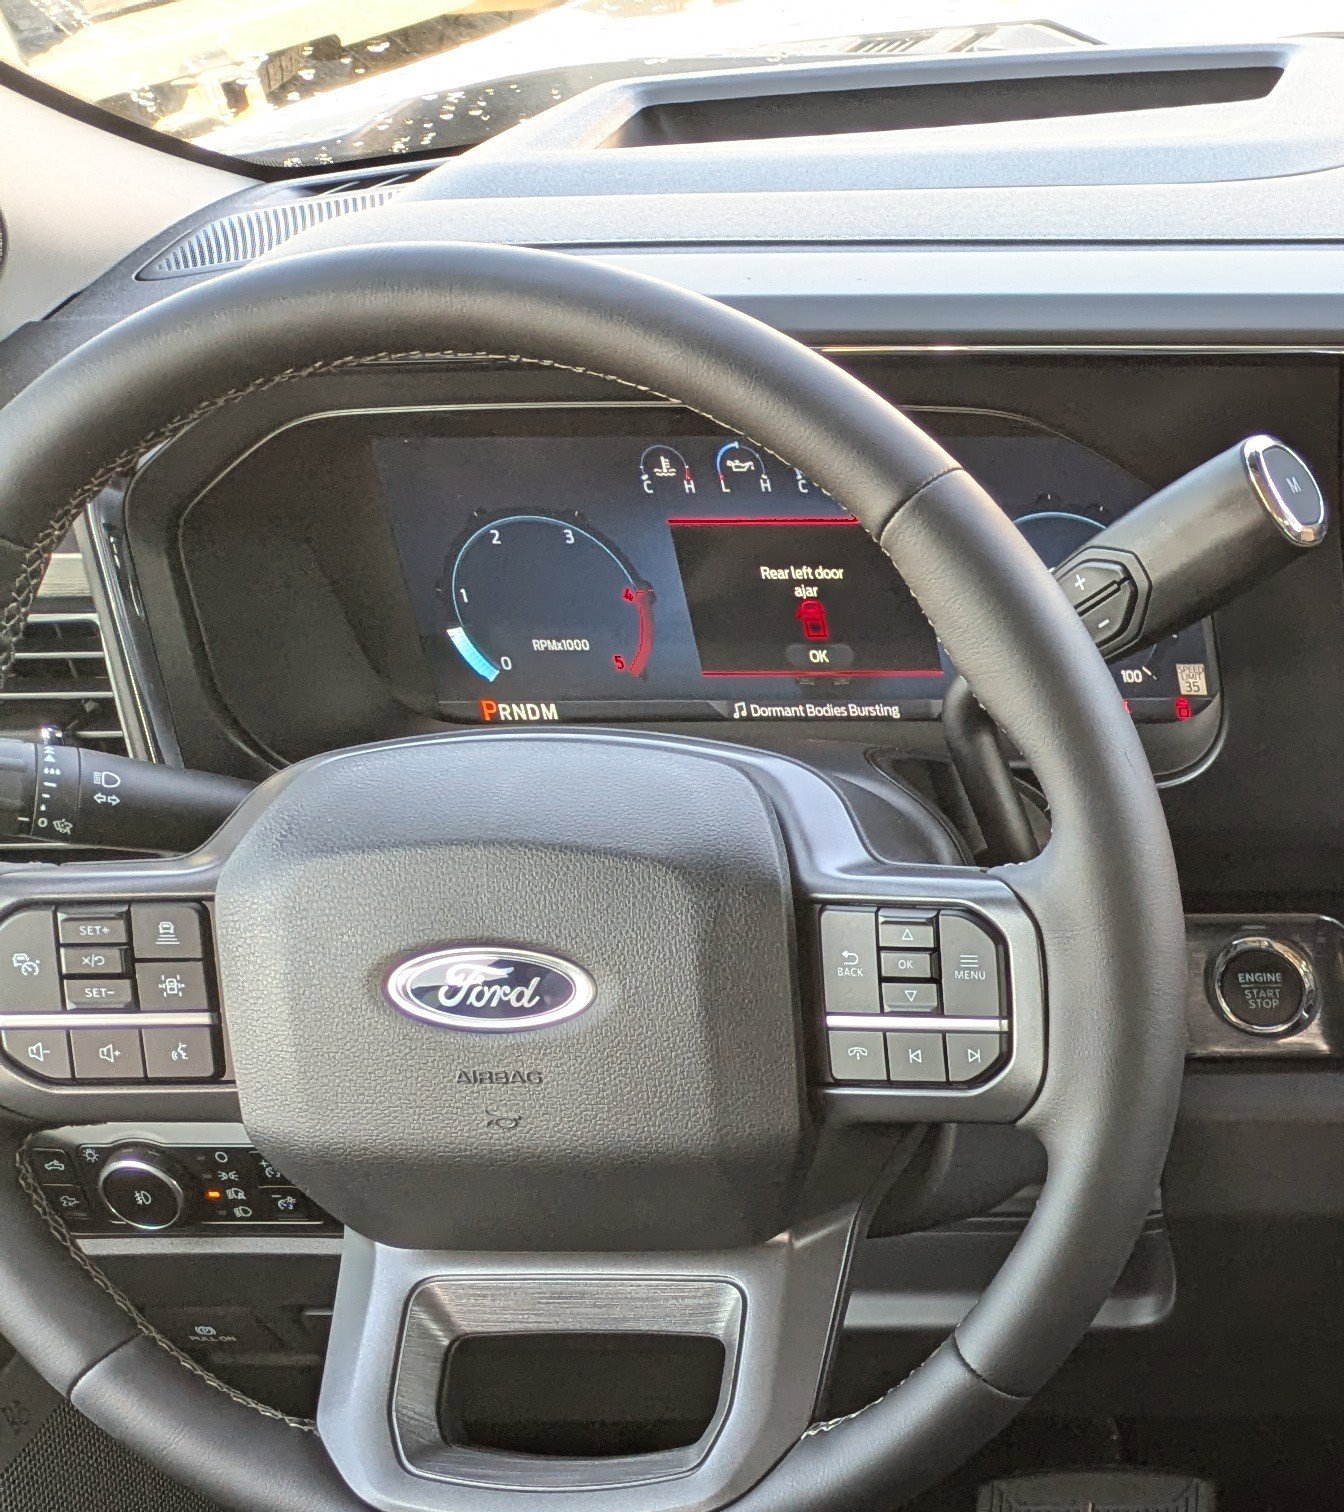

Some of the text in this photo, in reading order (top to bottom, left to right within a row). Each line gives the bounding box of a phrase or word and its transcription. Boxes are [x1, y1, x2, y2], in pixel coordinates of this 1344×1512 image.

[1287, 477, 1302, 493] M
[490, 529, 502, 544] 2
[563, 529, 575, 544] 3
[760, 566, 843, 580] Rear left door
[459, 588, 469, 603] 1
[794, 585, 818, 599] ajar
[532, 639, 590, 651] RPMx1000
[500, 656, 512, 671] 0
[613, 655, 625, 671] 5
[809, 650, 829, 663] OK
[1121, 669, 1143, 683] 100
[1185, 681, 1201, 693] 35
[751, 704, 900, 719] Dormant Bodies Bursting
[898, 960, 913, 969] OK
[837, 967, 864, 977] BACK
[954, 970, 986, 980] MENU
[1238, 972, 1282, 983] ENGINE
[438, 963, 541, 1008] Ford
[1244, 989, 1280, 999] START
[1249, 999, 1280, 1009] STOP
[456, 1070, 543, 1085] AIRBAG
